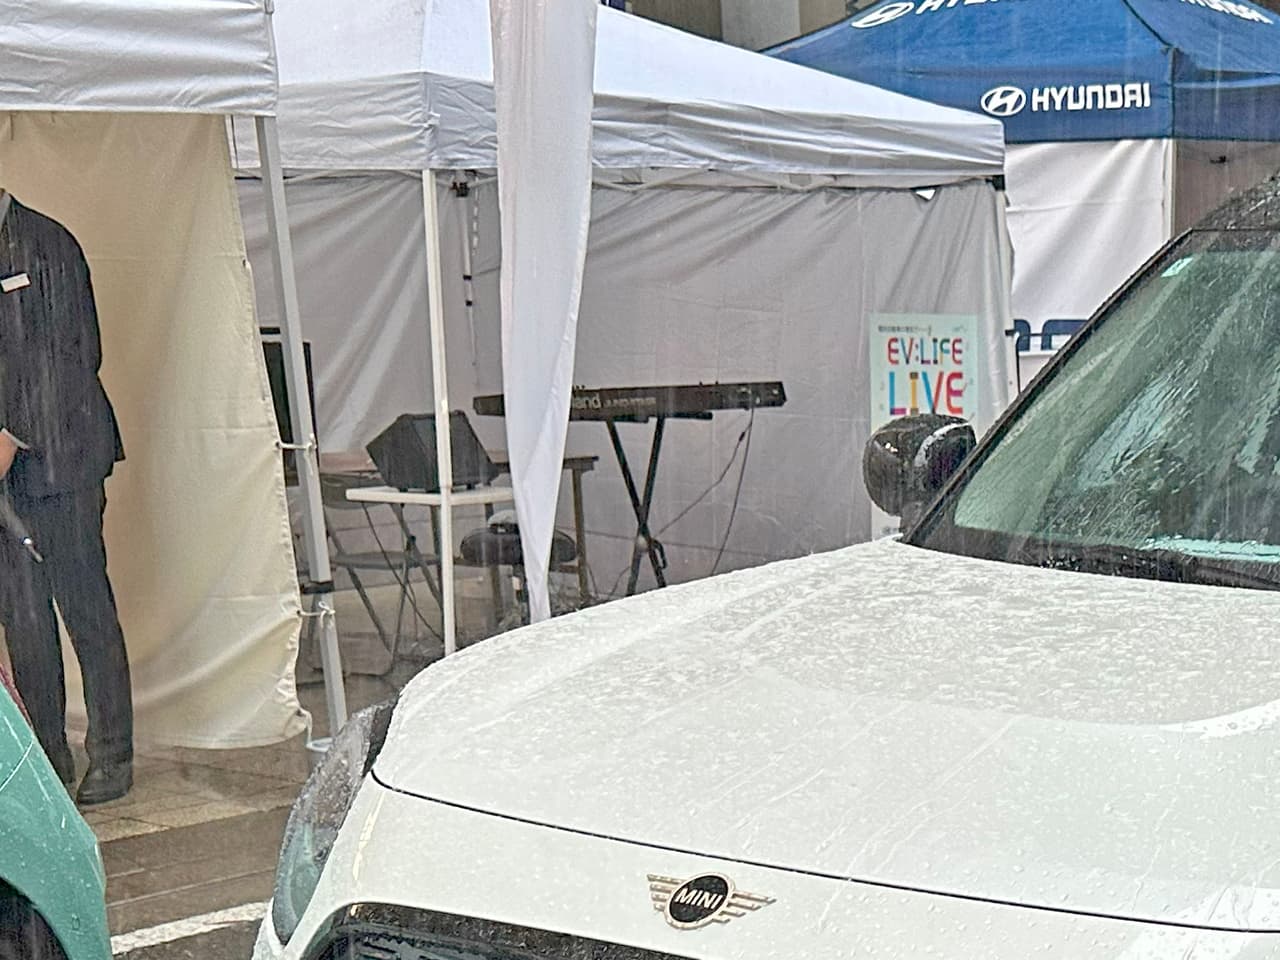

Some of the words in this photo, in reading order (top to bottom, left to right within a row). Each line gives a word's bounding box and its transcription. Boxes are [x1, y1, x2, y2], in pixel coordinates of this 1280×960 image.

[1031, 83, 1151, 112] HYUNDAI
[887, 337, 963, 365] EV:LIFE
[888, 371, 964, 416] LIVE
[675, 888, 723, 910] MINI
